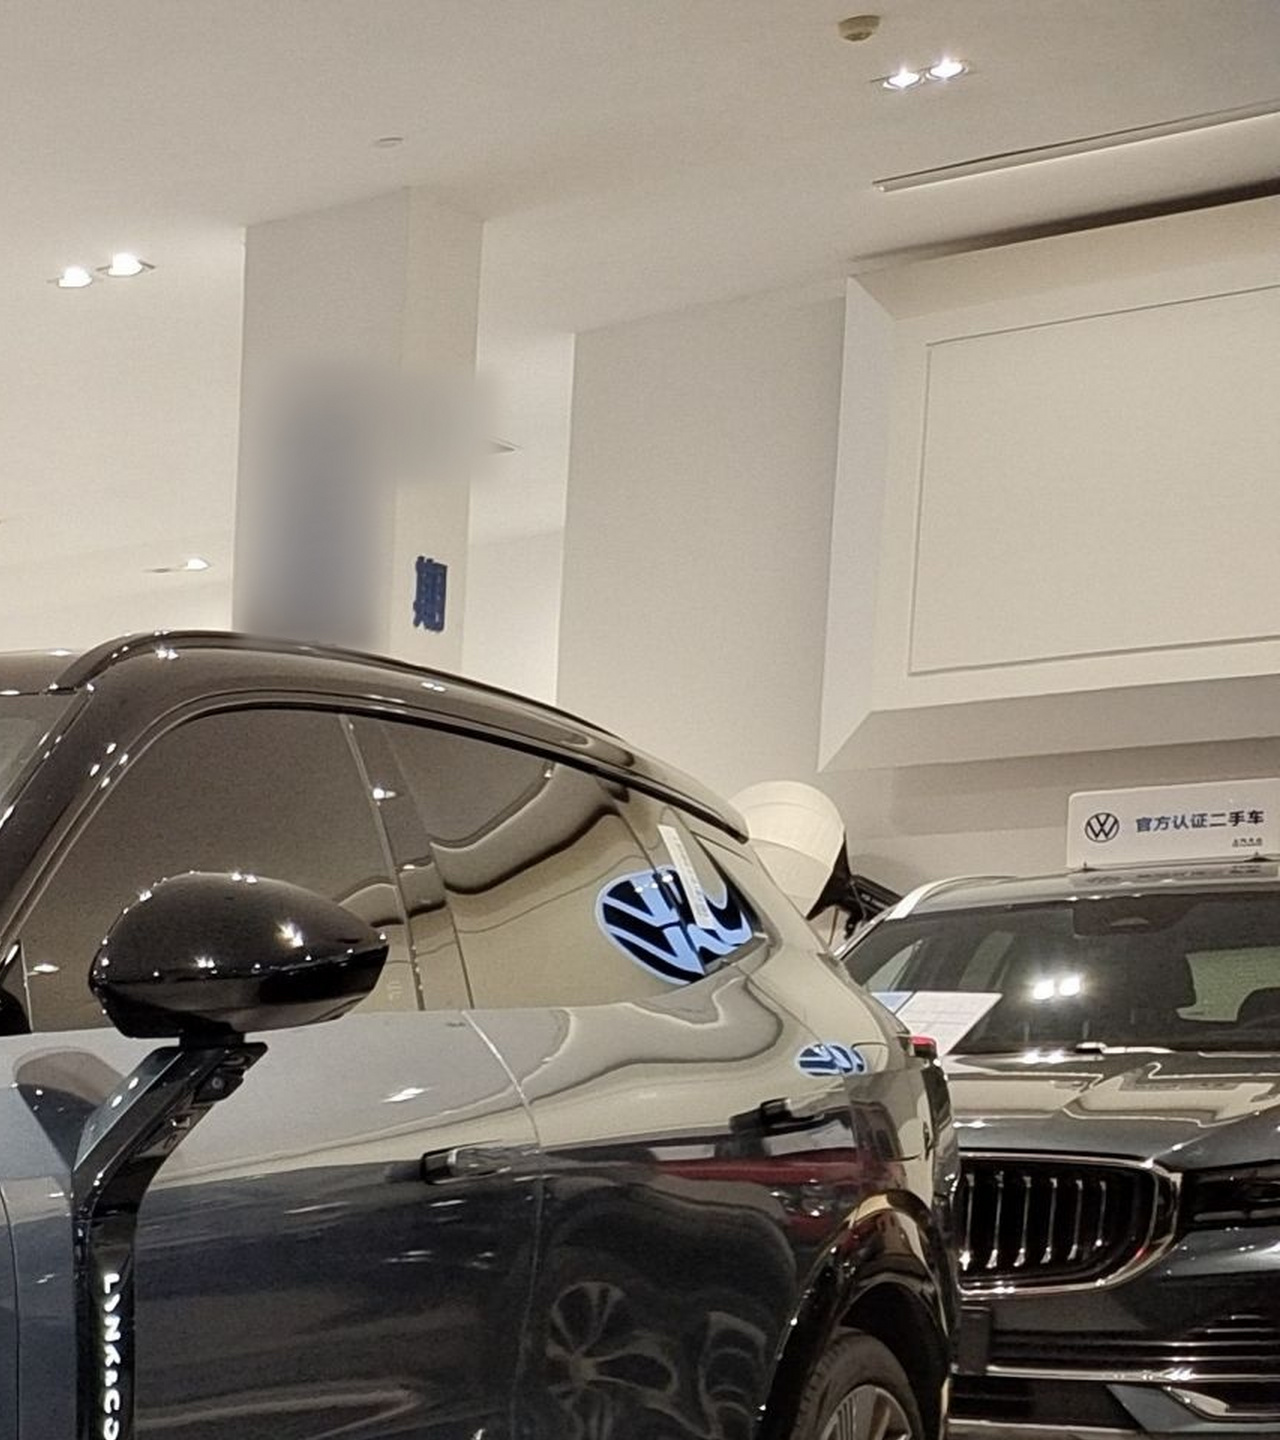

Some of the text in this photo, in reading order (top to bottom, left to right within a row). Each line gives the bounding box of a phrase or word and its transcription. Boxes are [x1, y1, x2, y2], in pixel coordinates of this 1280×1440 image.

[1136, 810, 1264, 833] 官方认证二手车
